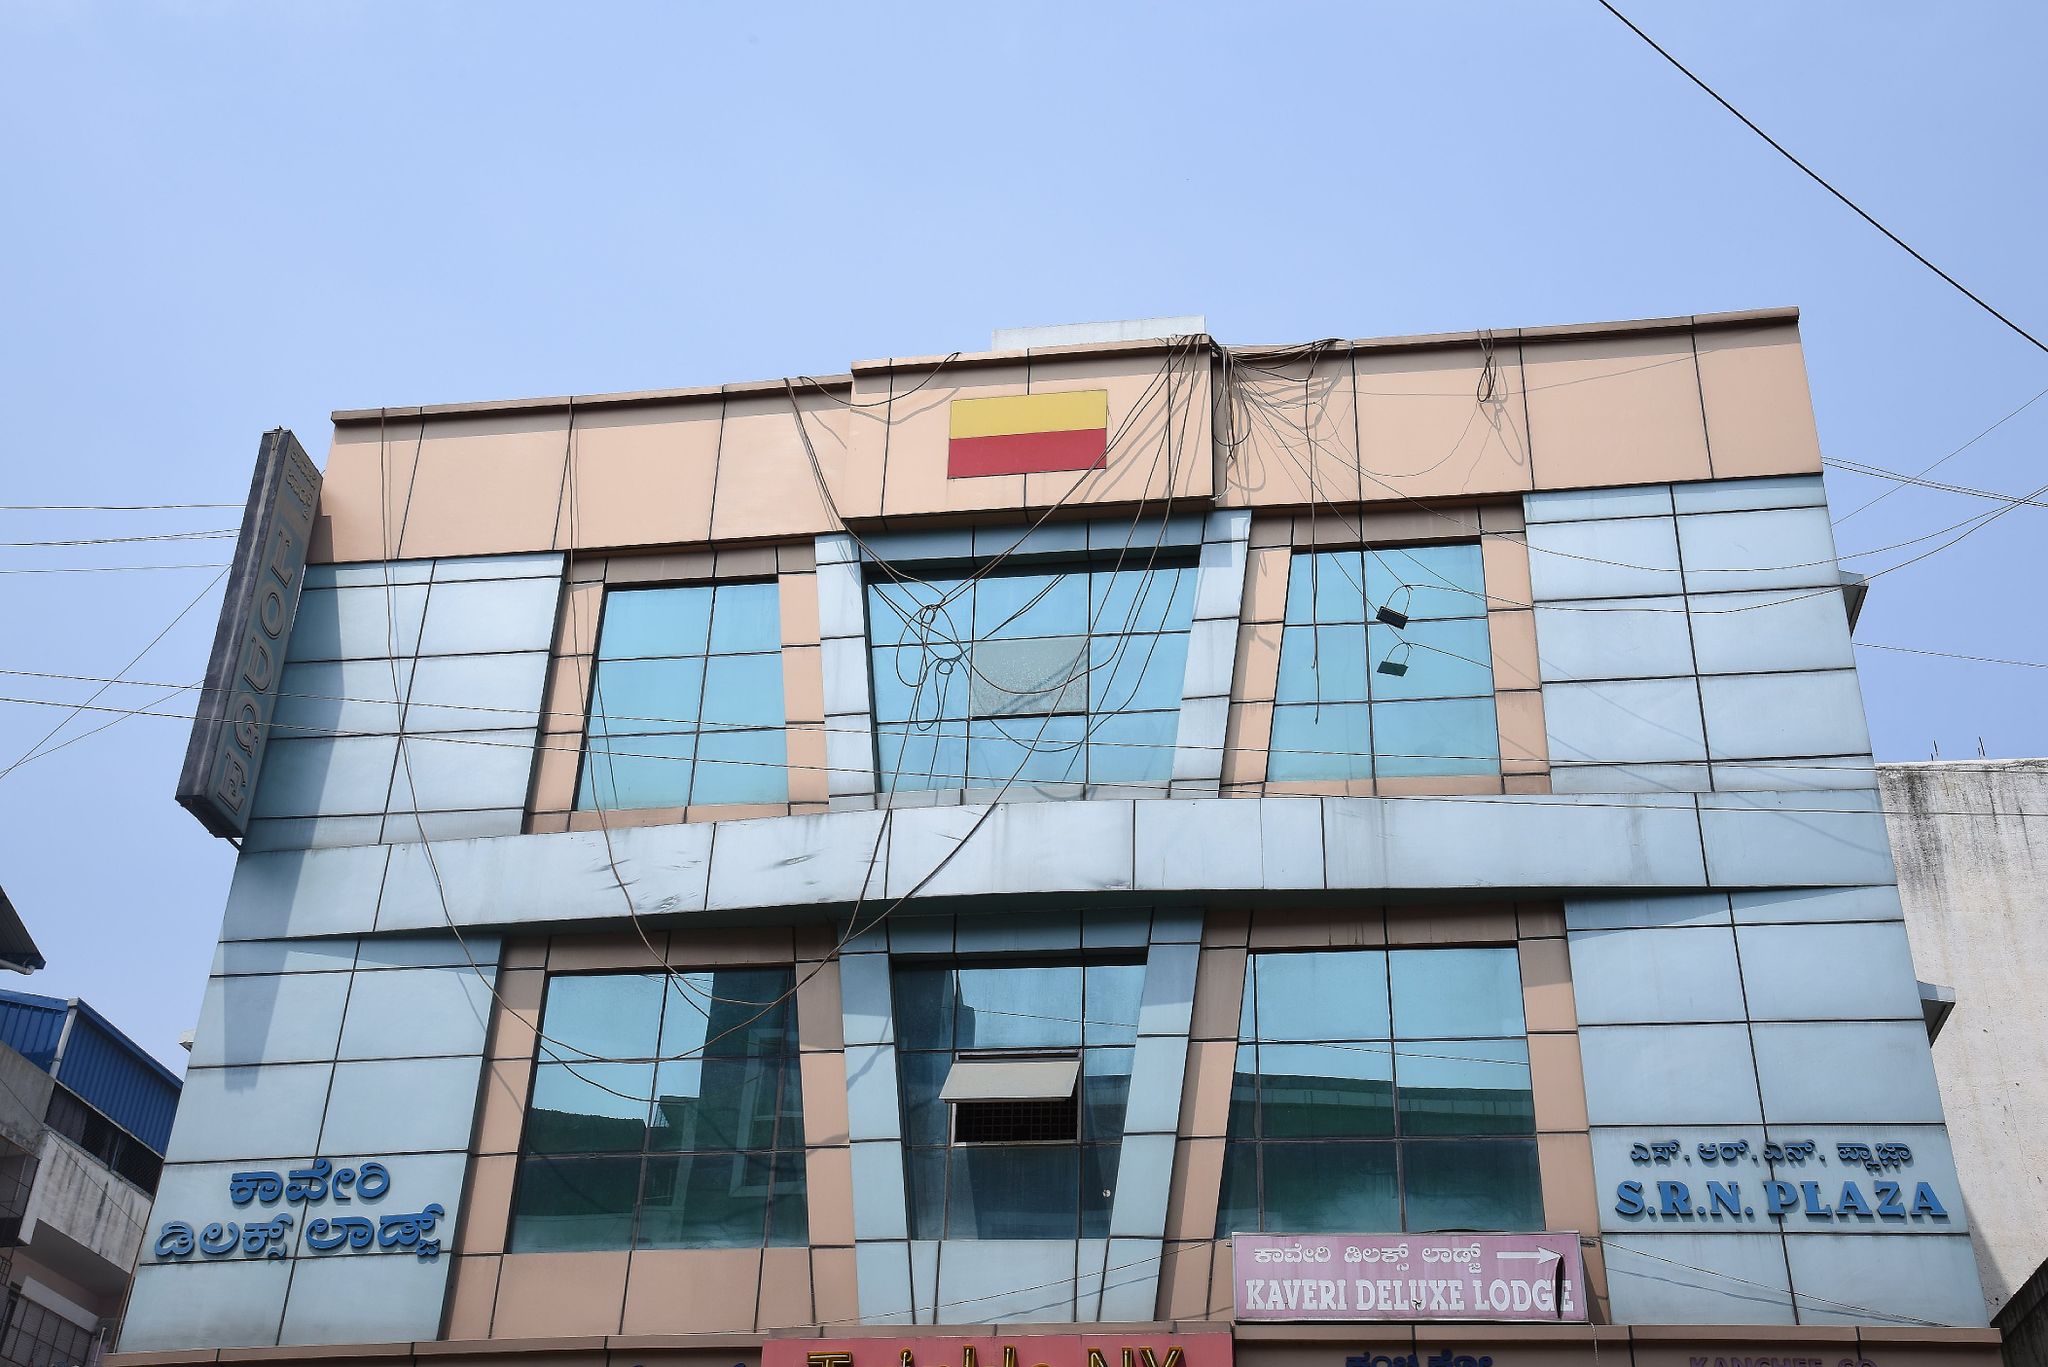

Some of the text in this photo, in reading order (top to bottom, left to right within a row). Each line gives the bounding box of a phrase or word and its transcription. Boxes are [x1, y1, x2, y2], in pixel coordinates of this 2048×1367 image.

[229, 1158, 391, 1203] ಕಾವೇರಿ
[1614, 1180, 1949, 1217] S.R.N. PLAZA
[154, 1203, 445, 1259] ಡಿಲಕ್ಸ್ ಲಾಡ್ಜ್
[1254, 1242, 1482, 1274] ಕಾವೇರಿ ಡಿಲಕ್ಸ್ ಲಾಡ್ಜ್
[1245, 1279, 1574, 1312] KAVERI DELUXE LODGE
